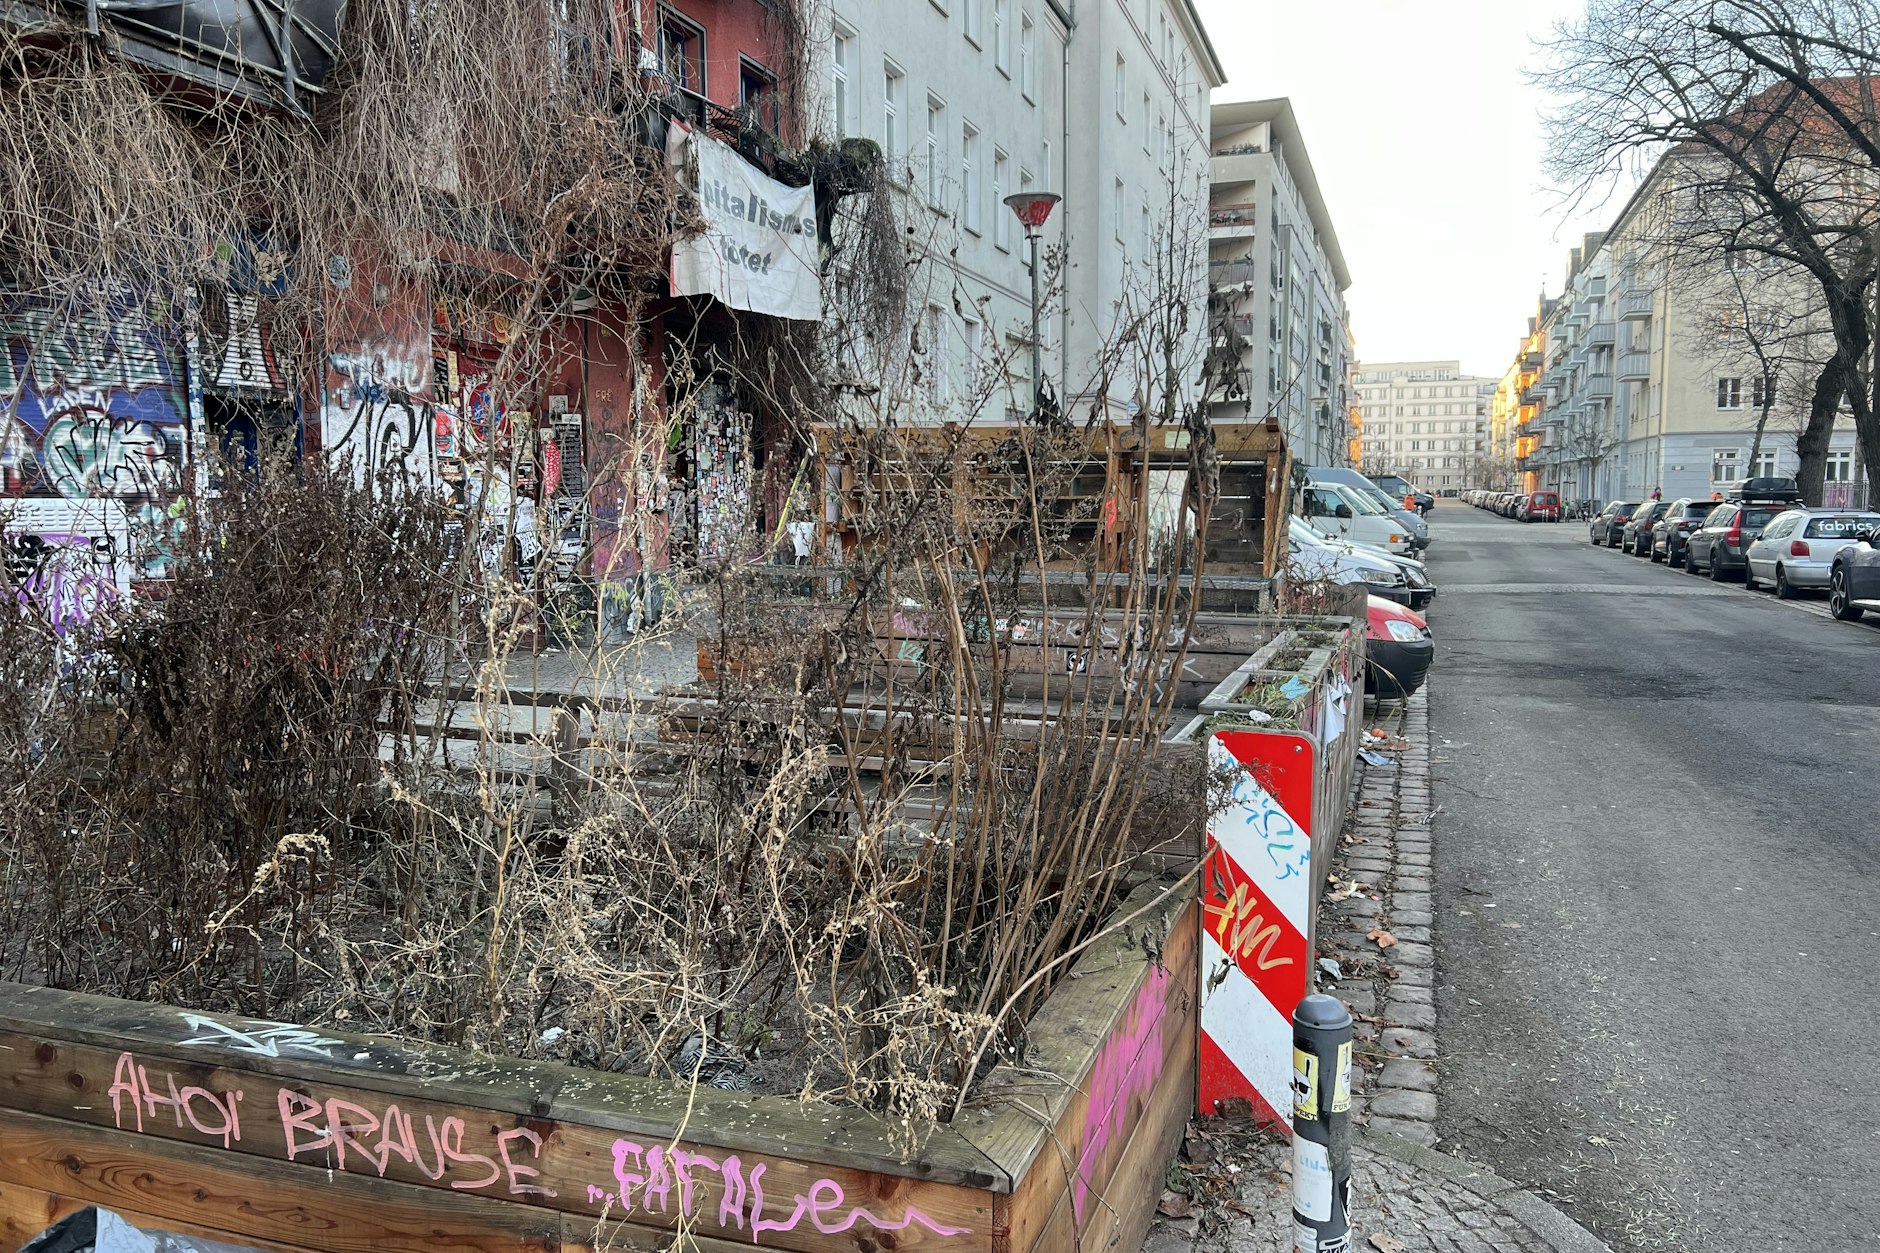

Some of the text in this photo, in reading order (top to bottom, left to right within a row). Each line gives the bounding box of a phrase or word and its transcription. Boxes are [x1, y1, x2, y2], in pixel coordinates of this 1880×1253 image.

[720, 235, 771, 275] tötet
[1818, 520, 1874, 531] fabrics
[278, 1088, 558, 1197] BRAUSE
